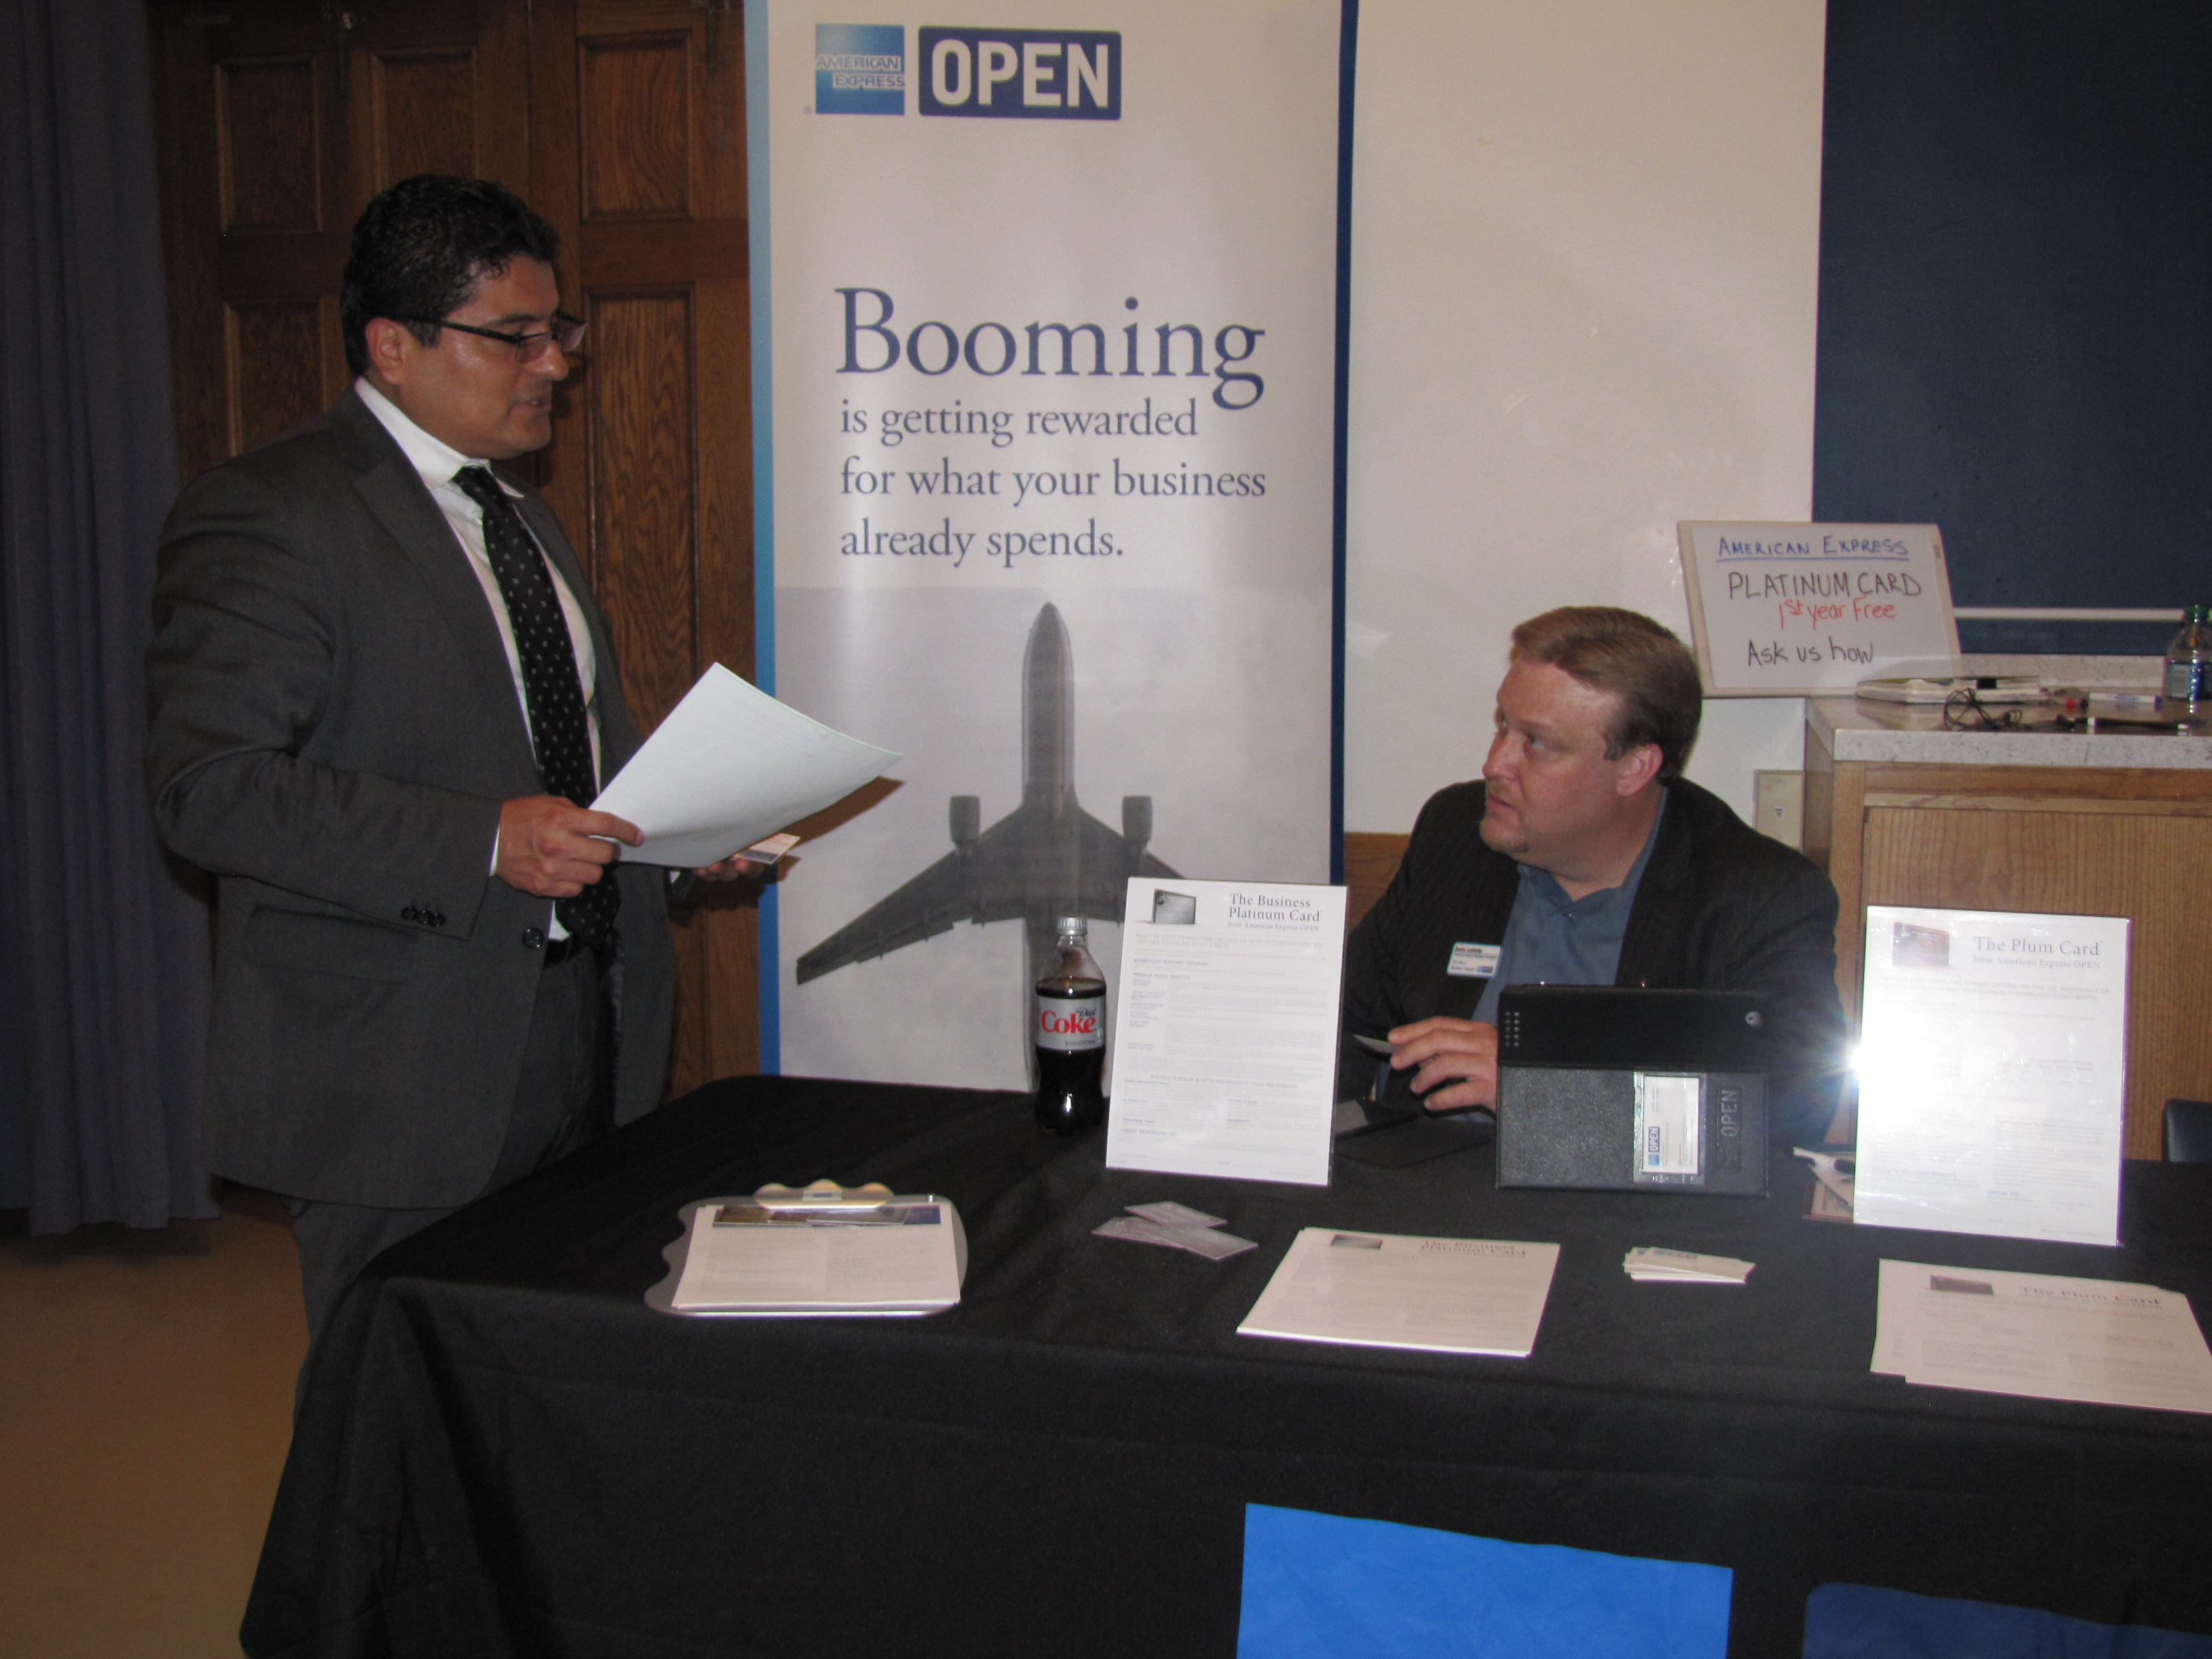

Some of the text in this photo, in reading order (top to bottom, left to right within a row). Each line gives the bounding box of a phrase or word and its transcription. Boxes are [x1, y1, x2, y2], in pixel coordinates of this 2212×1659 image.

[815, 55, 901, 70] AMERICAN
[932, 39, 1109, 108] OPEN
[834, 73, 905, 89] EXPRESS
[835, 287, 1265, 409] Booming
[841, 398, 1198, 447] is getting rewarded
[841, 455, 1266, 507] for what your business
[841, 517, 1124, 568] already spends.
[1728, 571, 1923, 600] PLATINUM CARD
[1807, 601, 1846, 630] year
[1852, 596, 1896, 622] Free
[1747, 636, 1875, 666] Ask us how
[1229, 906, 1320, 922] Platinum Card
[1230, 893, 1311, 907] The Business
[1974, 936, 2100, 956] The Plum Card
[1997, 956, 2036, 966] American
[2039, 958, 2070, 968] Express
[2073, 960, 2100, 969] OPEN
[1041, 1010, 1097, 1033] Coke
[1721, 1090, 1738, 1137] OPEN
[1650, 1127, 1659, 1151] OPEN
